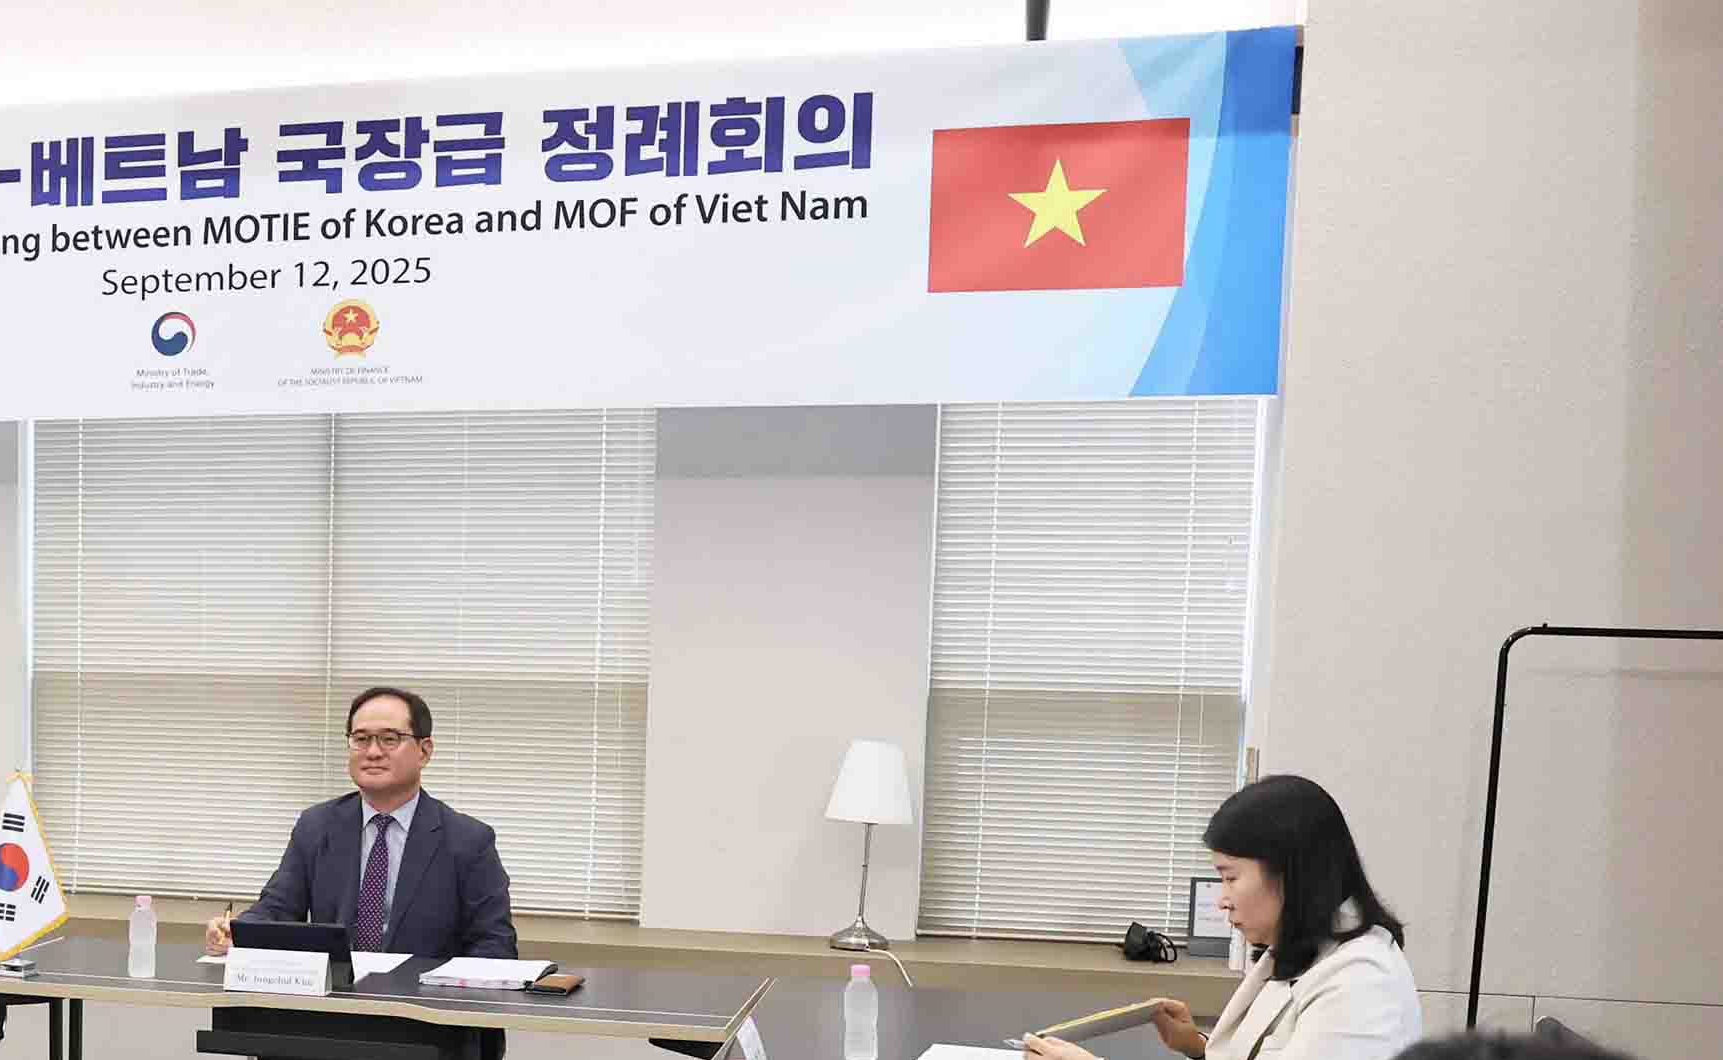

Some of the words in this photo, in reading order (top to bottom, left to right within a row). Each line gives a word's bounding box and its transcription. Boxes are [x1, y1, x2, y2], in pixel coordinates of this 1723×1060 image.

[276, 111, 505, 193] 국장급
[541, 91, 873, 182] 정례회의
[51, 223, 191, 252] between
[203, 211, 310, 244] MOTIE
[320, 207, 356, 239] of
[365, 208, 463, 237] Korea
[475, 200, 541, 232] and
[554, 197, 638, 229] MOF
[649, 192, 688, 226] of
[695, 192, 768, 224] Viet
[780, 190, 868, 221] Nam
[101, 264, 281, 300] September
[294, 260, 338, 290] 12,
[350, 257, 430, 285] 2025
